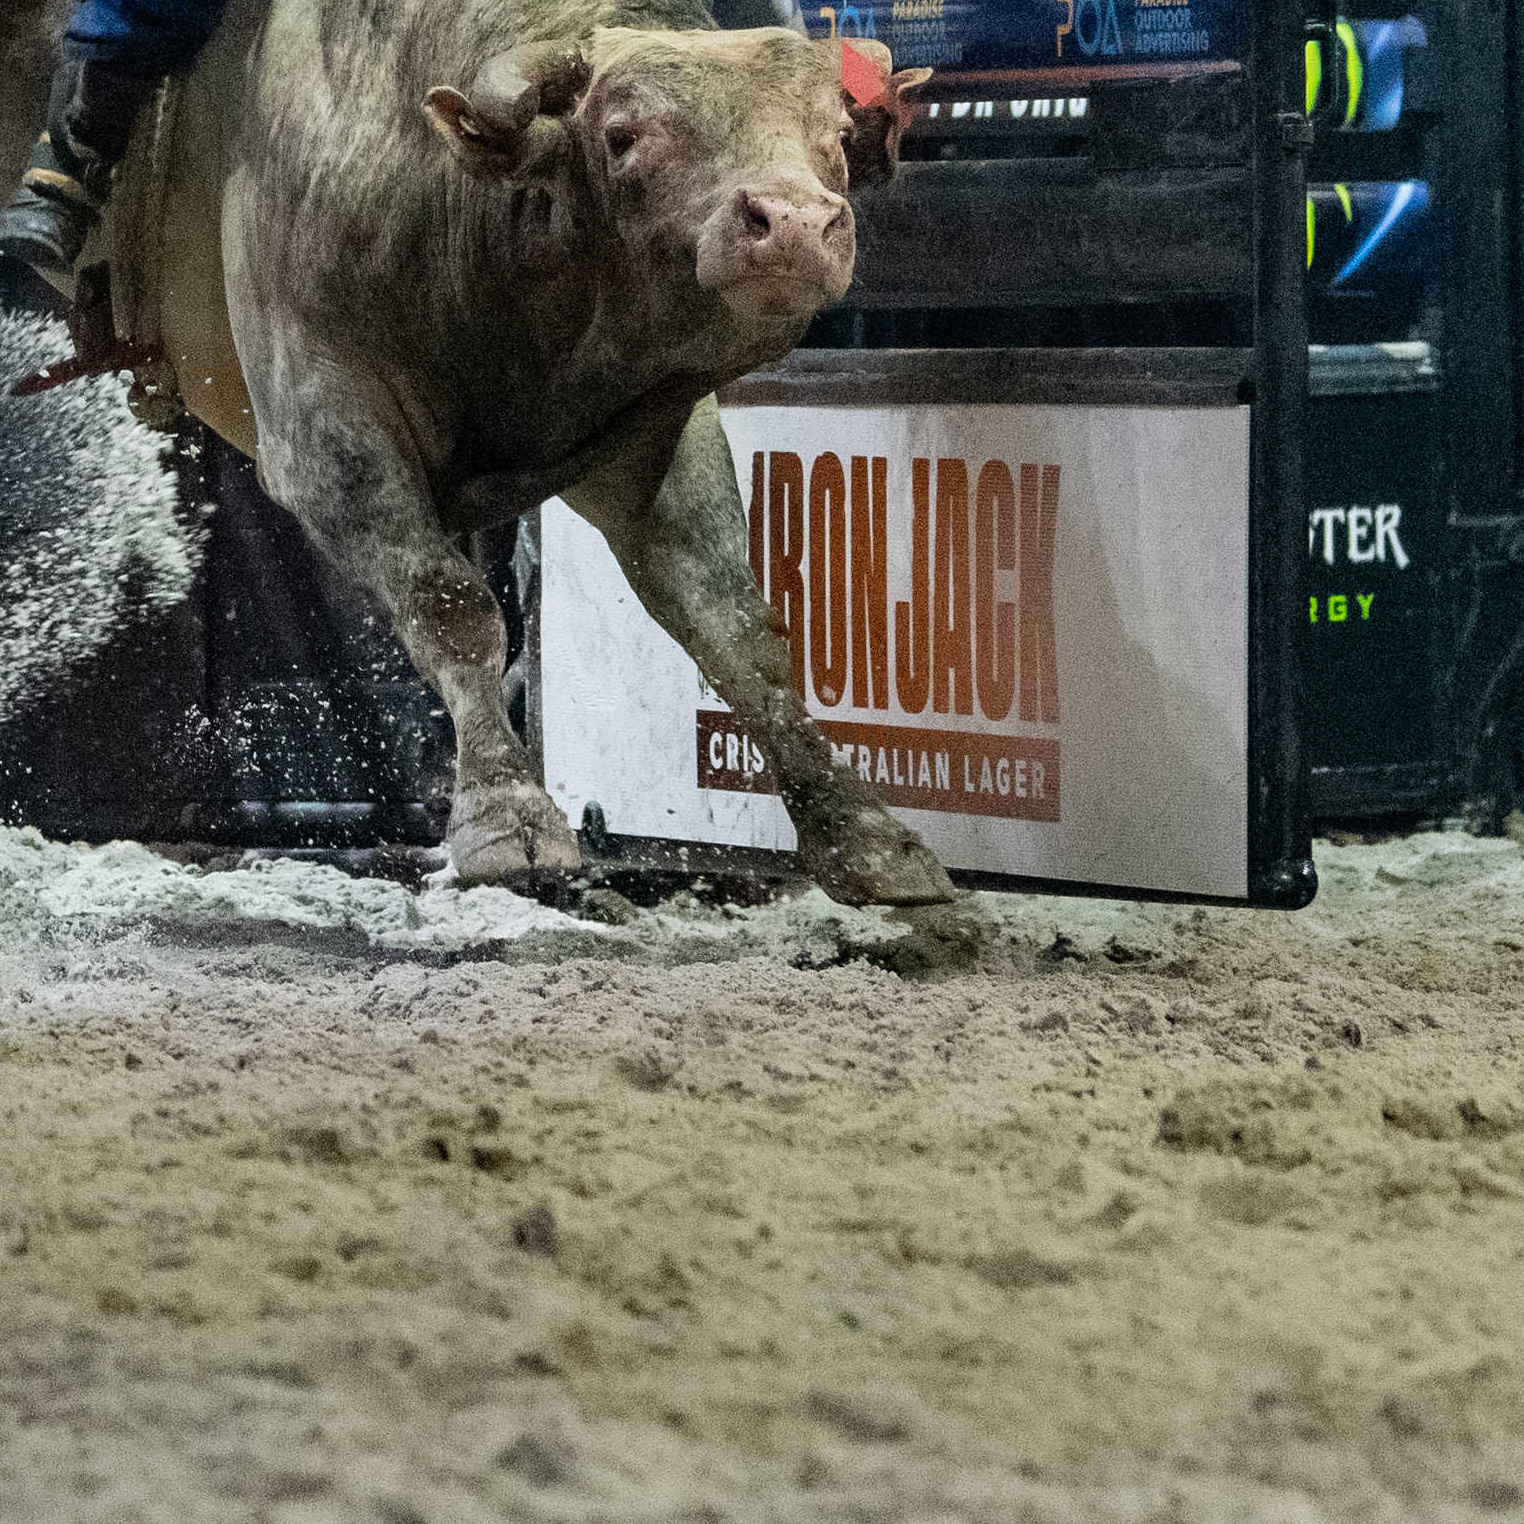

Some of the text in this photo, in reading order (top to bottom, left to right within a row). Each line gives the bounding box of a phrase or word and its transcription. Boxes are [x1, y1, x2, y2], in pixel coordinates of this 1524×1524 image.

[1309, 504, 1410, 570] TER
[709, 730, 765, 773] CRIS
[963, 755, 1046, 798] LAGER
